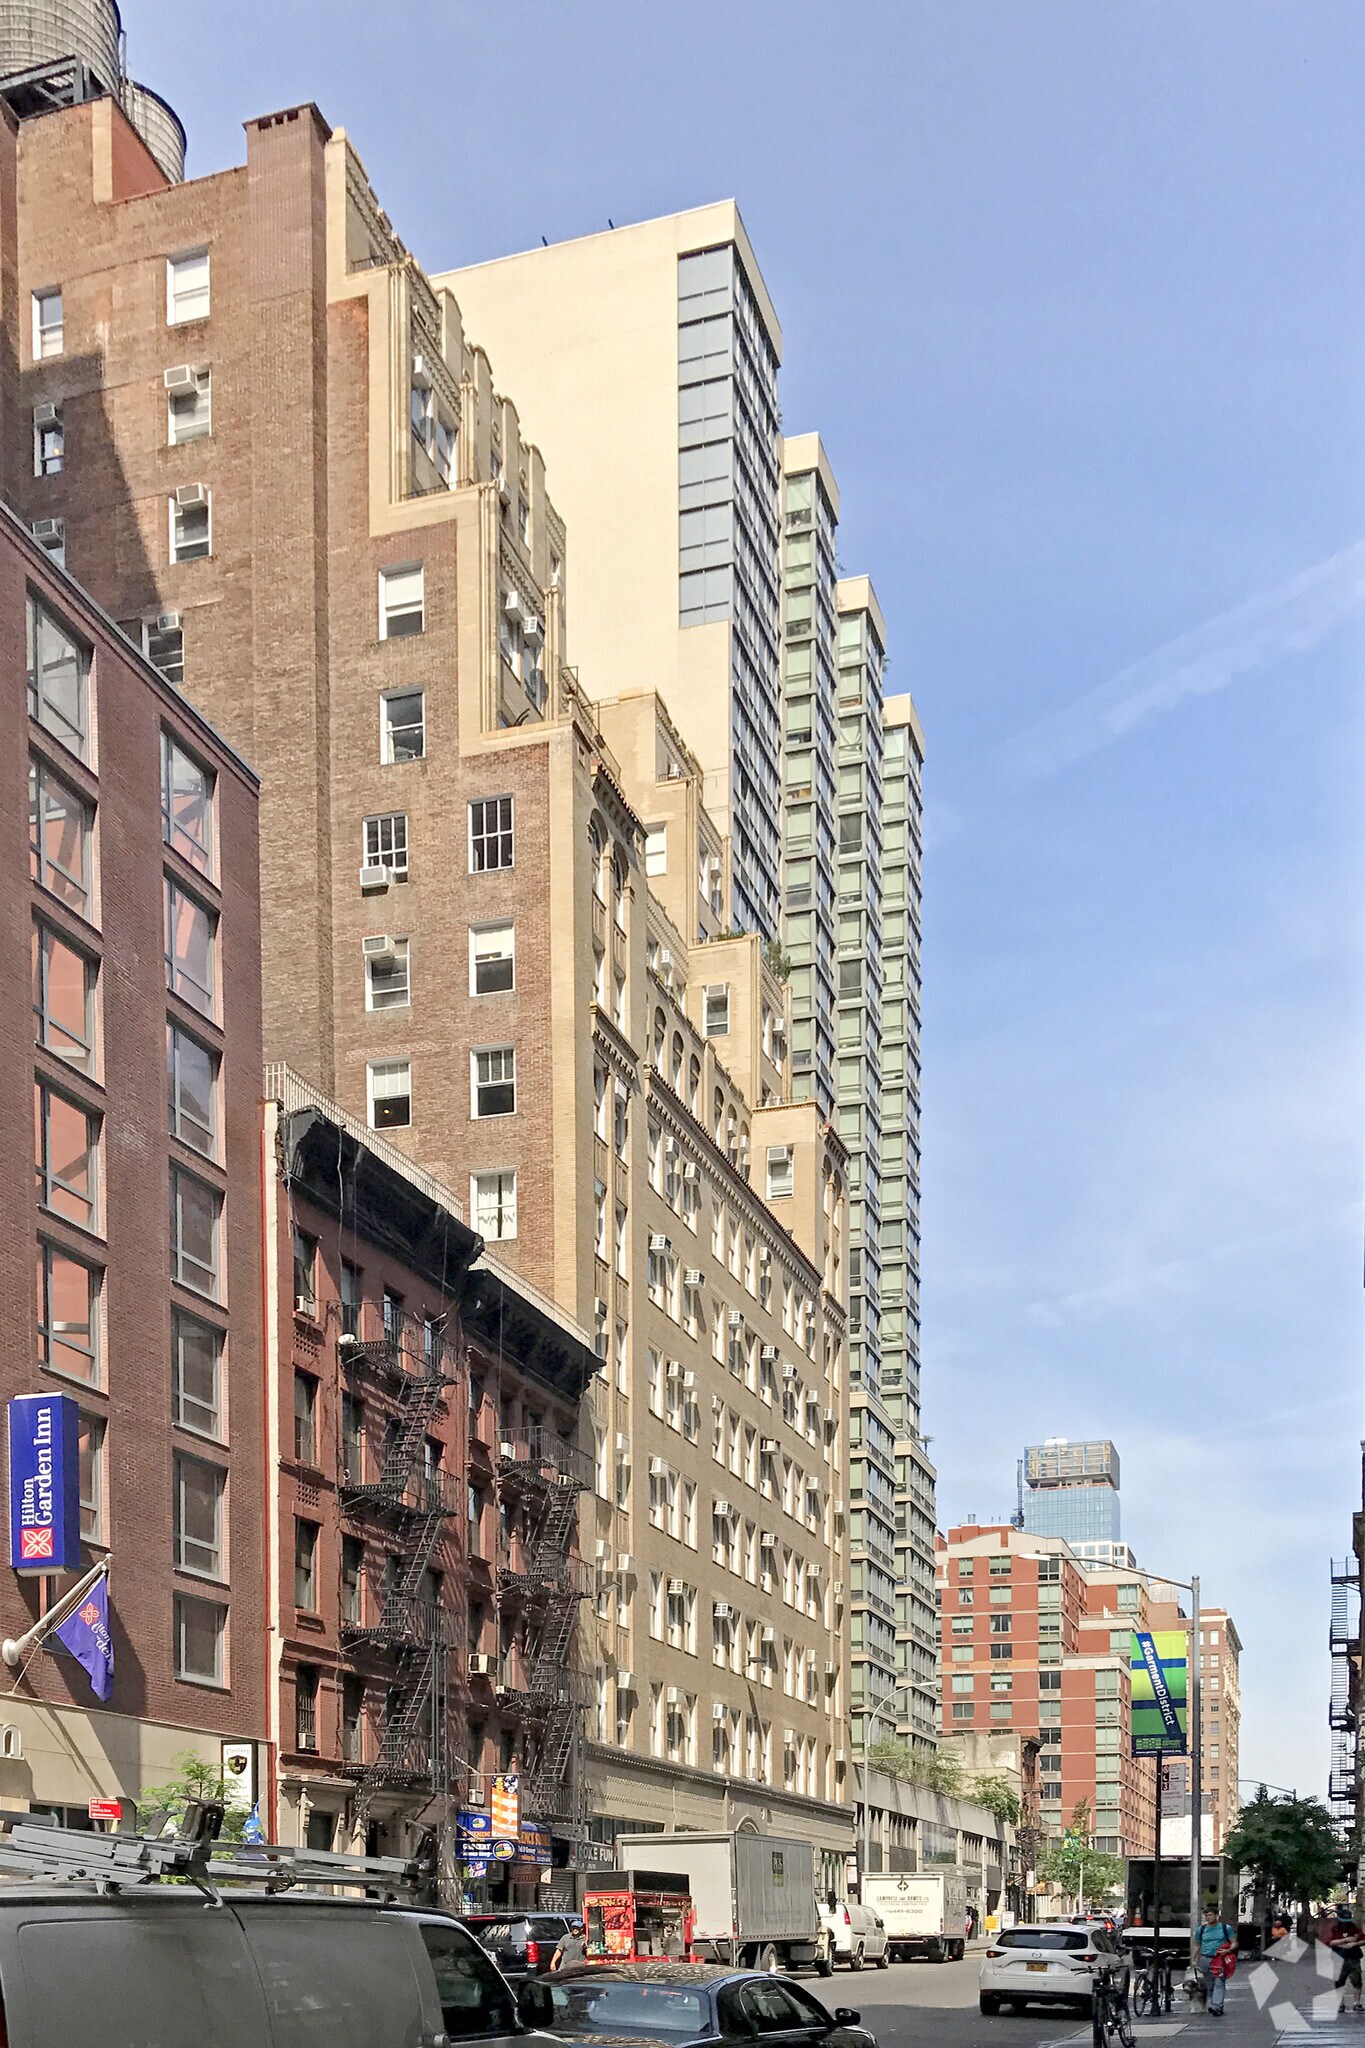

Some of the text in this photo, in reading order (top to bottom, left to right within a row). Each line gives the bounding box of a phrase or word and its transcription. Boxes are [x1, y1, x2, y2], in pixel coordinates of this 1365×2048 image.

[34, 1406, 53, 1526] Garden Inn
[22, 1478, 35, 1526] Hilton
[1141, 1640, 1175, 1726] #GarmentDistrict
[600, 1847, 613, 1862] FUN
